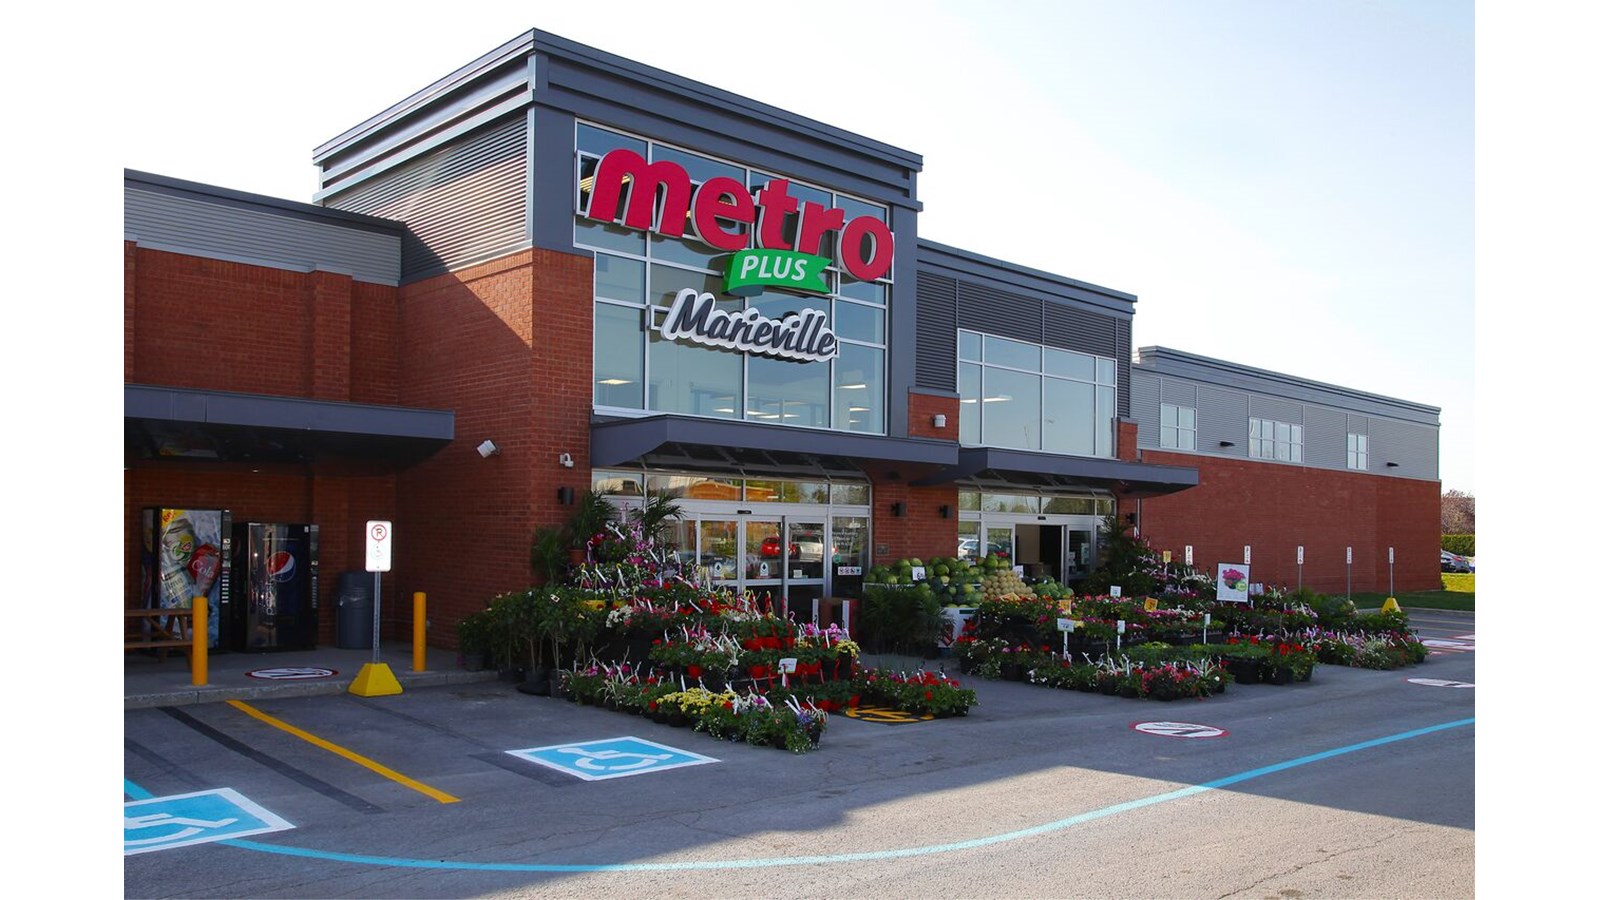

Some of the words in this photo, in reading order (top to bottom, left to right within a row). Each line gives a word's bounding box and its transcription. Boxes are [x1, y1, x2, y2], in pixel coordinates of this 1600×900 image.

[587, 148, 894, 282] metro
[740, 255, 808, 281] PLUS
[670, 293, 836, 356] Marieville
[191, 560, 215, 578] Cola
